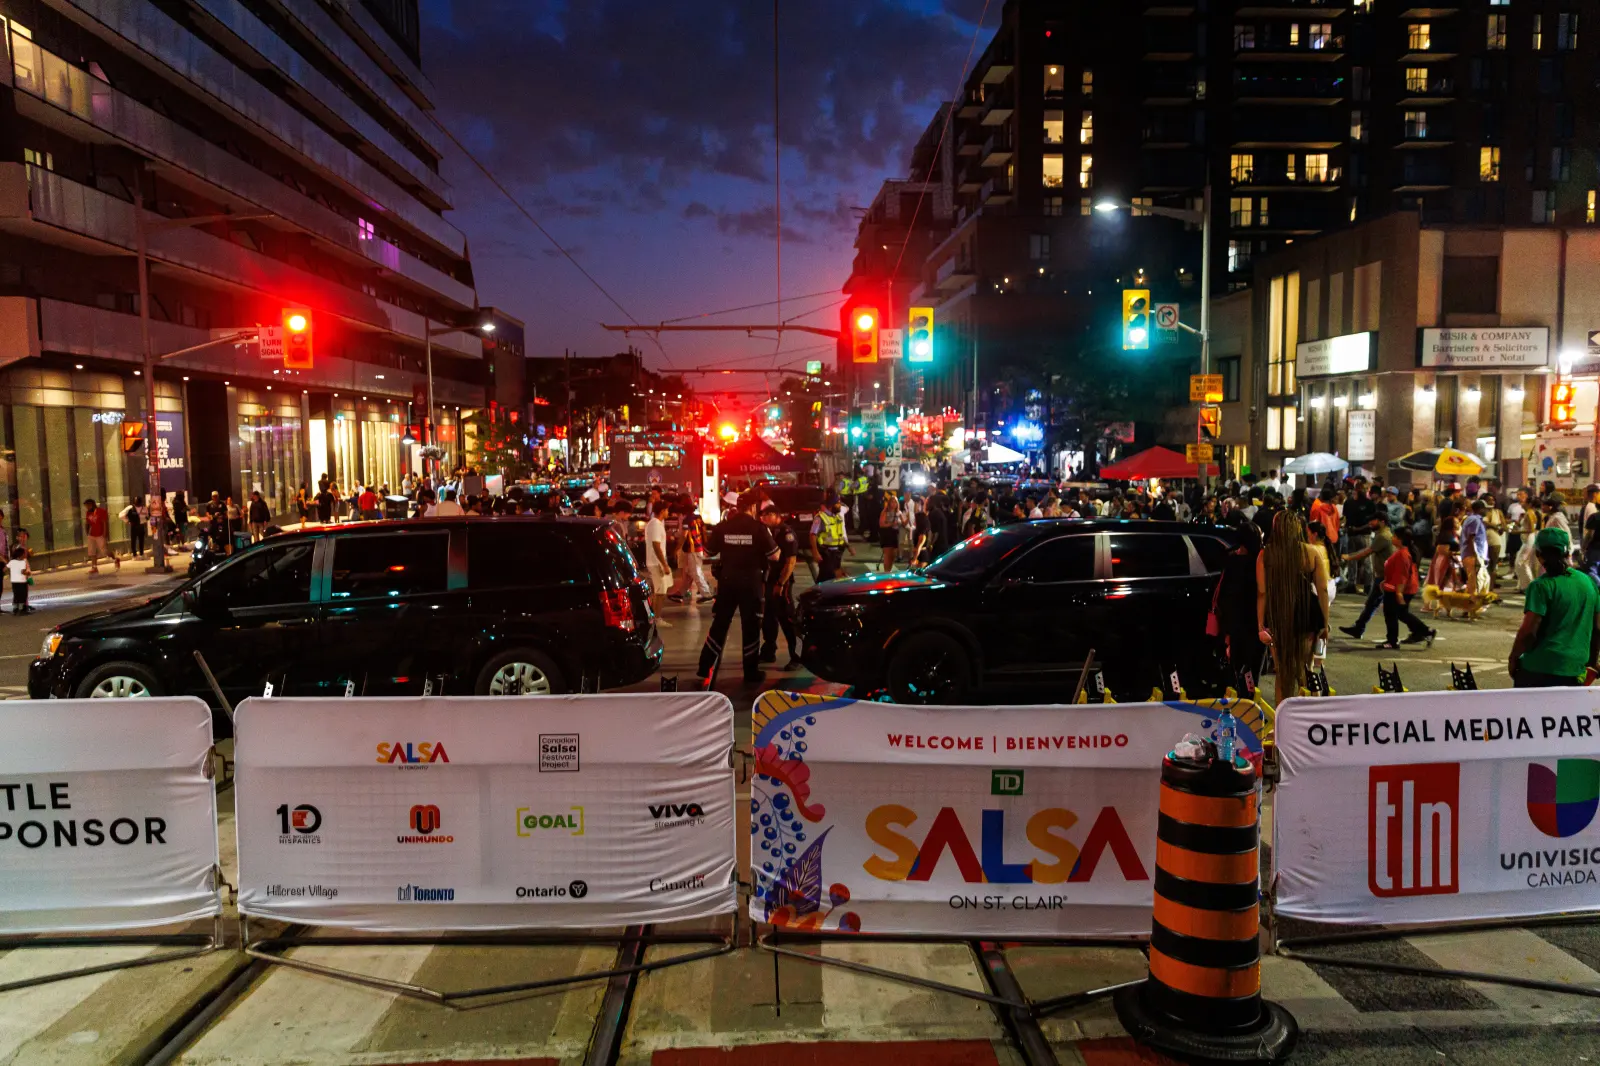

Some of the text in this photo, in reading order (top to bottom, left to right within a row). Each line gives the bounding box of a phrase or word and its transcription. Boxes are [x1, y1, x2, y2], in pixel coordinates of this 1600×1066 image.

[262, 339, 282, 347] TURN
[1439, 331, 1532, 341] MISIR & COMPANY
[261, 348, 284, 356] SIGNAL
[1432, 343, 1538, 353] Barristers & Solicitors
[749, 464, 781, 472] Division
[1307, 719, 1435, 746] OFFICIAL
[1444, 717, 1533, 742] MEDIA
[541, 736, 577, 744] Canadian
[887, 733, 1129, 750] WELCOME BIENVENIDO
[376, 741, 450, 764] SALSA
[541, 743, 577, 753] Salsa
[541, 753, 577, 761] Festivals
[541, 760, 570, 769] Project
[994, 773, 1021, 791] TD
[523, 814, 578, 829] GOAL
[397, 835, 454, 844] UNIMUNDO
[1375, 780, 1452, 890] tln
[862, 803, 1150, 885] SALSA
[649, 875, 705, 893] Canada
[1526, 868, 1597, 888] CANADA
[266, 884, 339, 899] Hillcrest Village
[412, 885, 455, 901] TORONTO
[515, 885, 567, 898] Ontario
[948, 895, 977, 910] ON
[983, 895, 1006, 910] ST.
